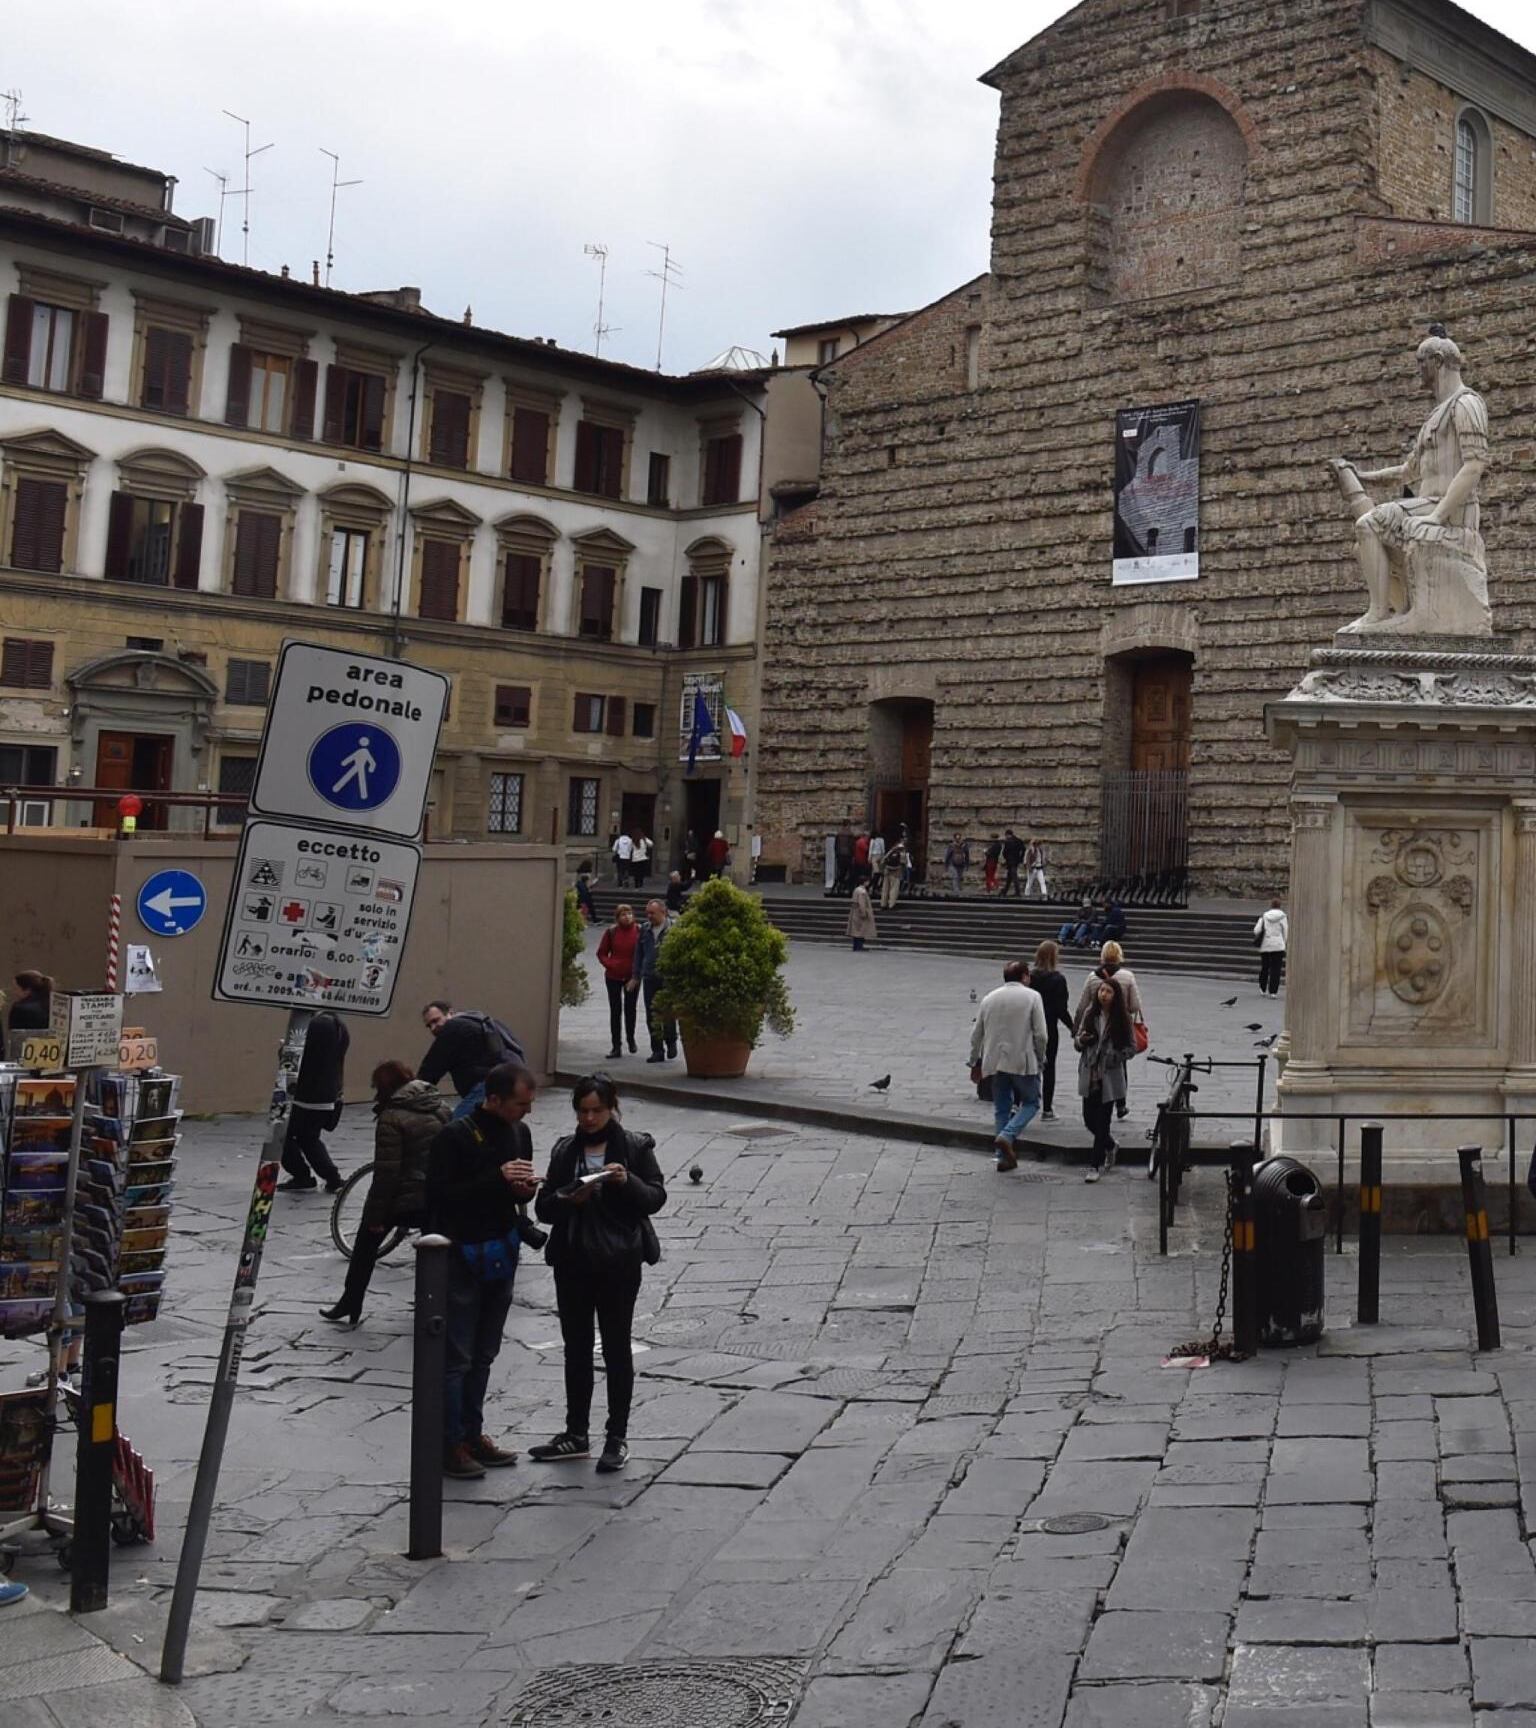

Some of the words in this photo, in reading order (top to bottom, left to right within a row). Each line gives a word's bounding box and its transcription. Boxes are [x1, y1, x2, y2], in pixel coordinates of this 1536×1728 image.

[346, 665, 403, 689] area
[306, 685, 422, 721] pedonale
[297, 839, 381, 863] eccetto
[359, 902, 383, 914] solo
[385, 903, 397, 916] in
[353, 915, 397, 930] servizio
[80, 1001, 115, 1009] STAMPS
[24, 1044, 60, 1064] 0,40
[119, 1043, 157, 1065] 0,20
